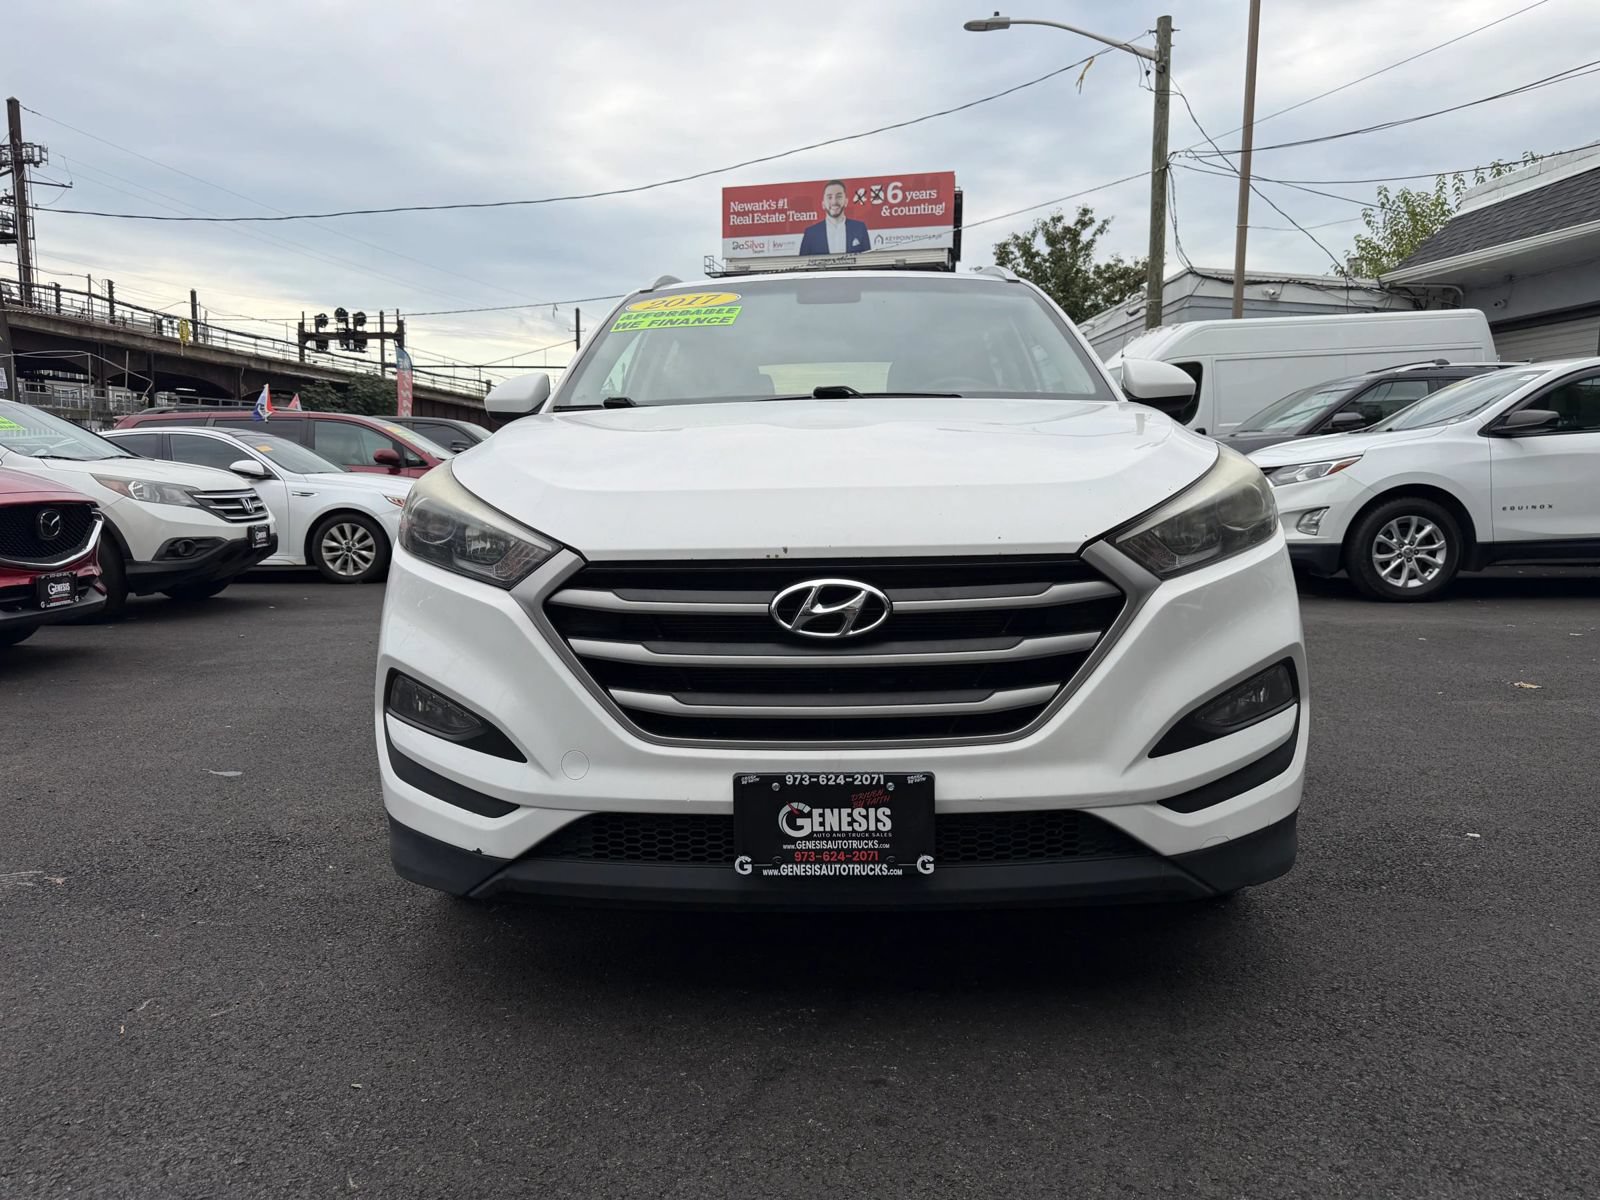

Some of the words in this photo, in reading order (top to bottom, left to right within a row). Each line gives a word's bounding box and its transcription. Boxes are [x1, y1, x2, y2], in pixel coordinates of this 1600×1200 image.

[886, 181, 903, 204] 6
[905, 189, 937, 202] years
[777, 198, 788, 209] #1
[881, 205, 891, 216] &
[891, 202, 945, 216] counting!
[729, 213, 753, 225] Real
[753, 211, 786, 224] Estate
[786, 210, 818, 222] Team
[643, 294, 722, 310] 2017
[619, 306, 739, 321] AFFORDABLE
[613, 320, 643, 331] WE
[647, 316, 735, 328] FINANCE
[1502, 504, 1553, 512] EQUINOX
[785, 774, 885, 785] 973-624-2071
[778, 802, 892, 837] GENESIS
[794, 851, 879, 862] 973-624-2071
[735, 855, 752, 875] G
[917, 855, 935, 875] G
